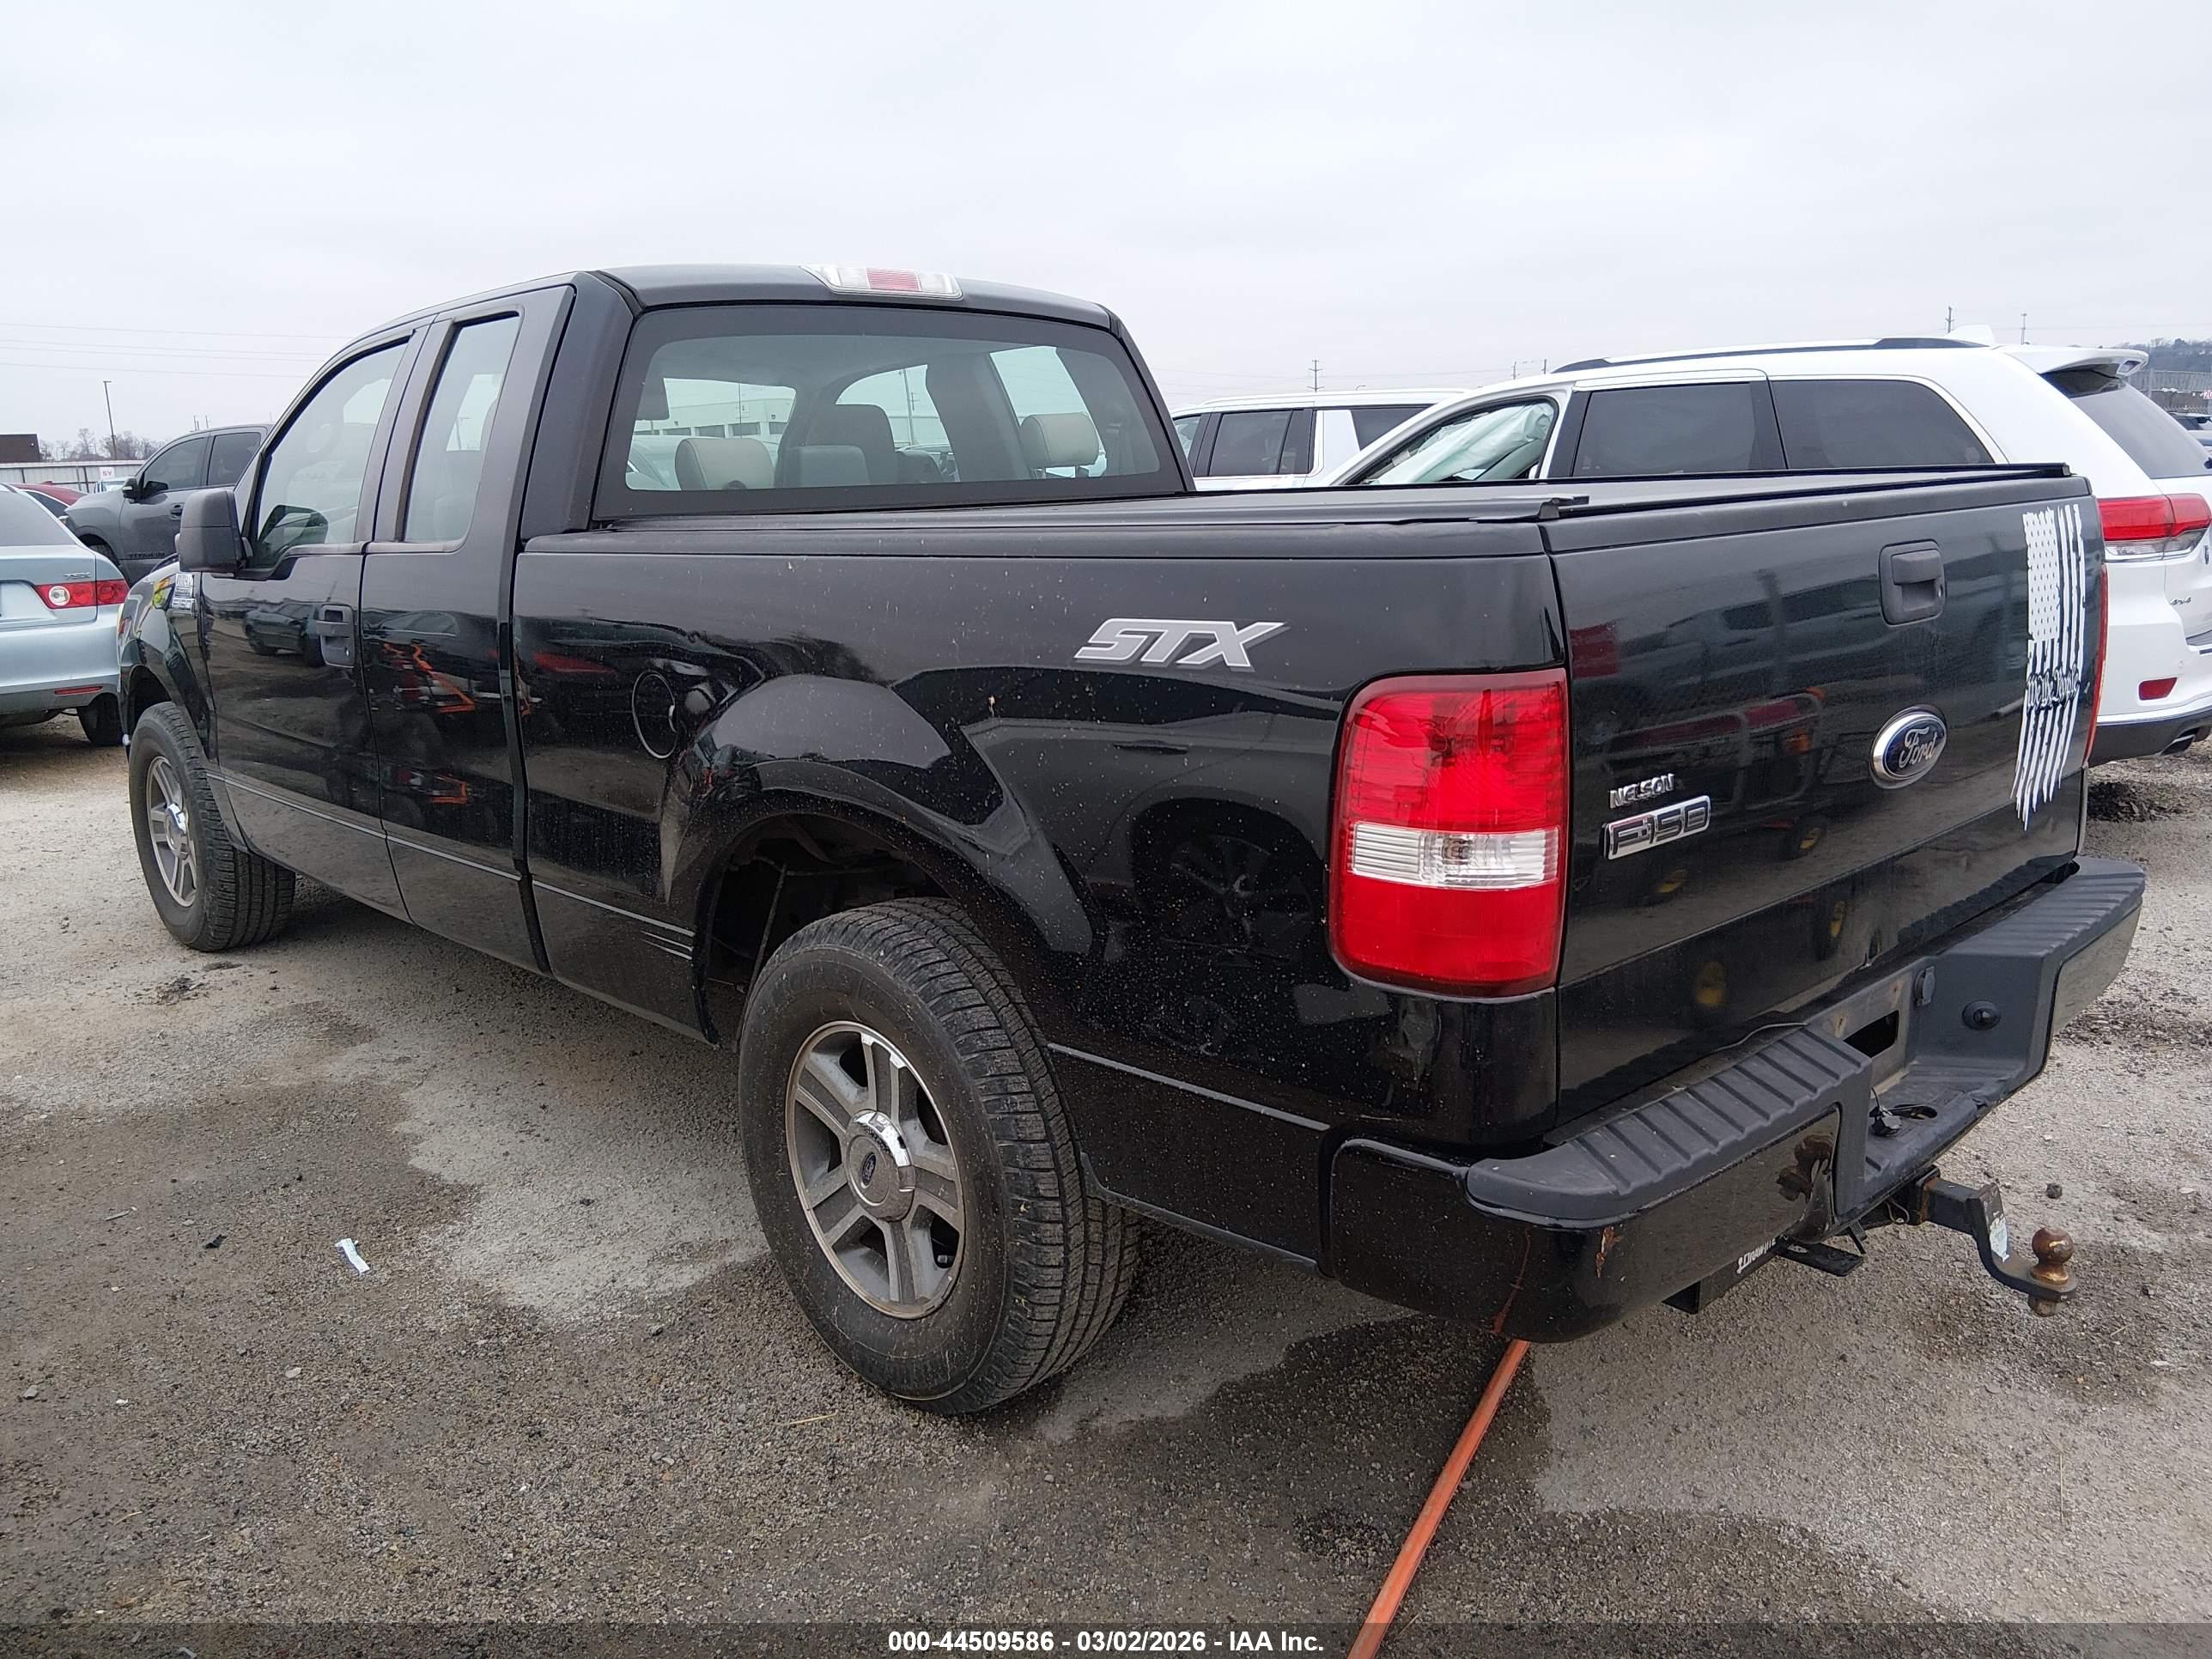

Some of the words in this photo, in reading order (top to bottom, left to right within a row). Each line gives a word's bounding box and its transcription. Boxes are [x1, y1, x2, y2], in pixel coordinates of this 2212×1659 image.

[1073, 618, 1287, 670] STX
[1899, 726, 1937, 768] Ford
[1609, 774, 1674, 808] NELSON
